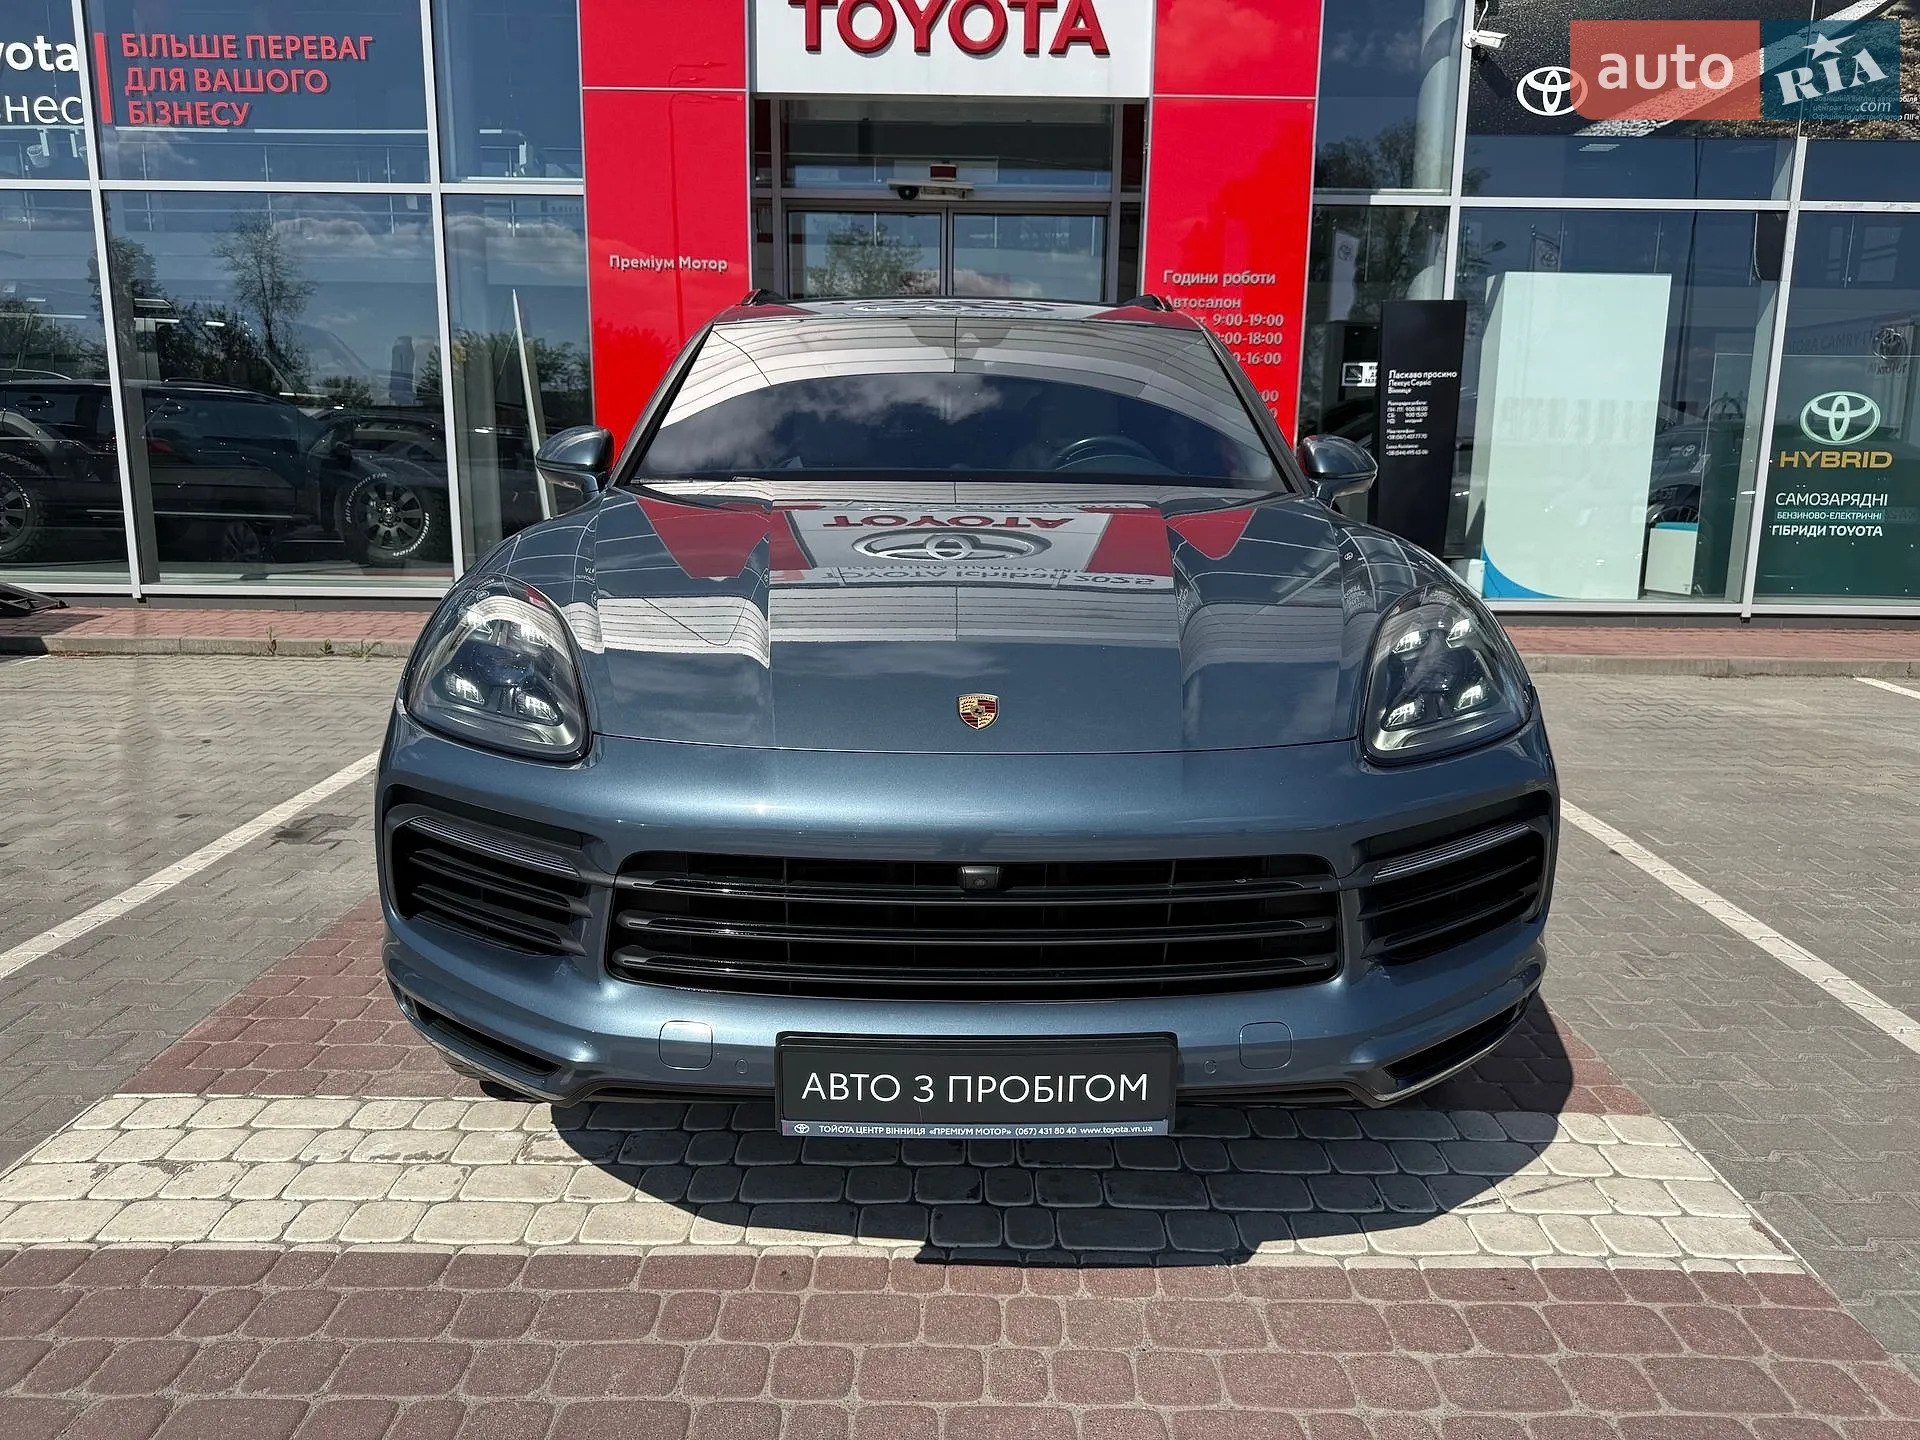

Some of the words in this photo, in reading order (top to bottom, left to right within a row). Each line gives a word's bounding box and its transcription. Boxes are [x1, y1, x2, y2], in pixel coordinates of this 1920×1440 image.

[788, 0, 1111, 55] TOYOTA
[0, 36, 79, 71] ota
[121, 33, 238, 58] БІЛЬШЕ
[246, 35, 373, 60] ПЕРЕВАГ
[125, 67, 185, 95] ДЛЯ
[194, 68, 328, 93] ВАШОГО
[0, 95, 83, 124] нес
[128, 100, 249, 126] БІЗНЕСУ
[609, 255, 675, 271] Преміум
[679, 256, 728, 272] Мотор
[1163, 270, 1218, 286] Години
[1223, 270, 1276, 287] роботи
[1213, 314, 1284, 326] 9:00-19:00
[1780, 451, 1893, 468] HYBRID
[1776, 493, 1888, 508] САМОЗАРЯДНІ
[1777, 511, 1882, 520] БЕНЗИНОВО-ЕЛЕКТРИЧНІ
[1772, 525, 1826, 537] ГІБРИДИ
[1829, 525, 1883, 537] TOYOTA
[802, 1073, 901, 1101] АВТО
[913, 1075, 934, 1102] З
[948, 1074, 1148, 1102] ПРОБІГОМ
[819, 1125, 854, 1134] ТОЙОТА
[856, 1126, 884, 1135] ЦЕНТР
[886, 1127, 926, 1136] ВІННИЦЯ
[1015, 1127, 1037, 1136] (067)
[1039, 1127, 1052, 1135] 431
[1054, 1127, 1064, 1135] 80
[1066, 1127, 1077, 1135] 40
[1080, 1125, 1153, 1135] www.toyota.vn.ua
